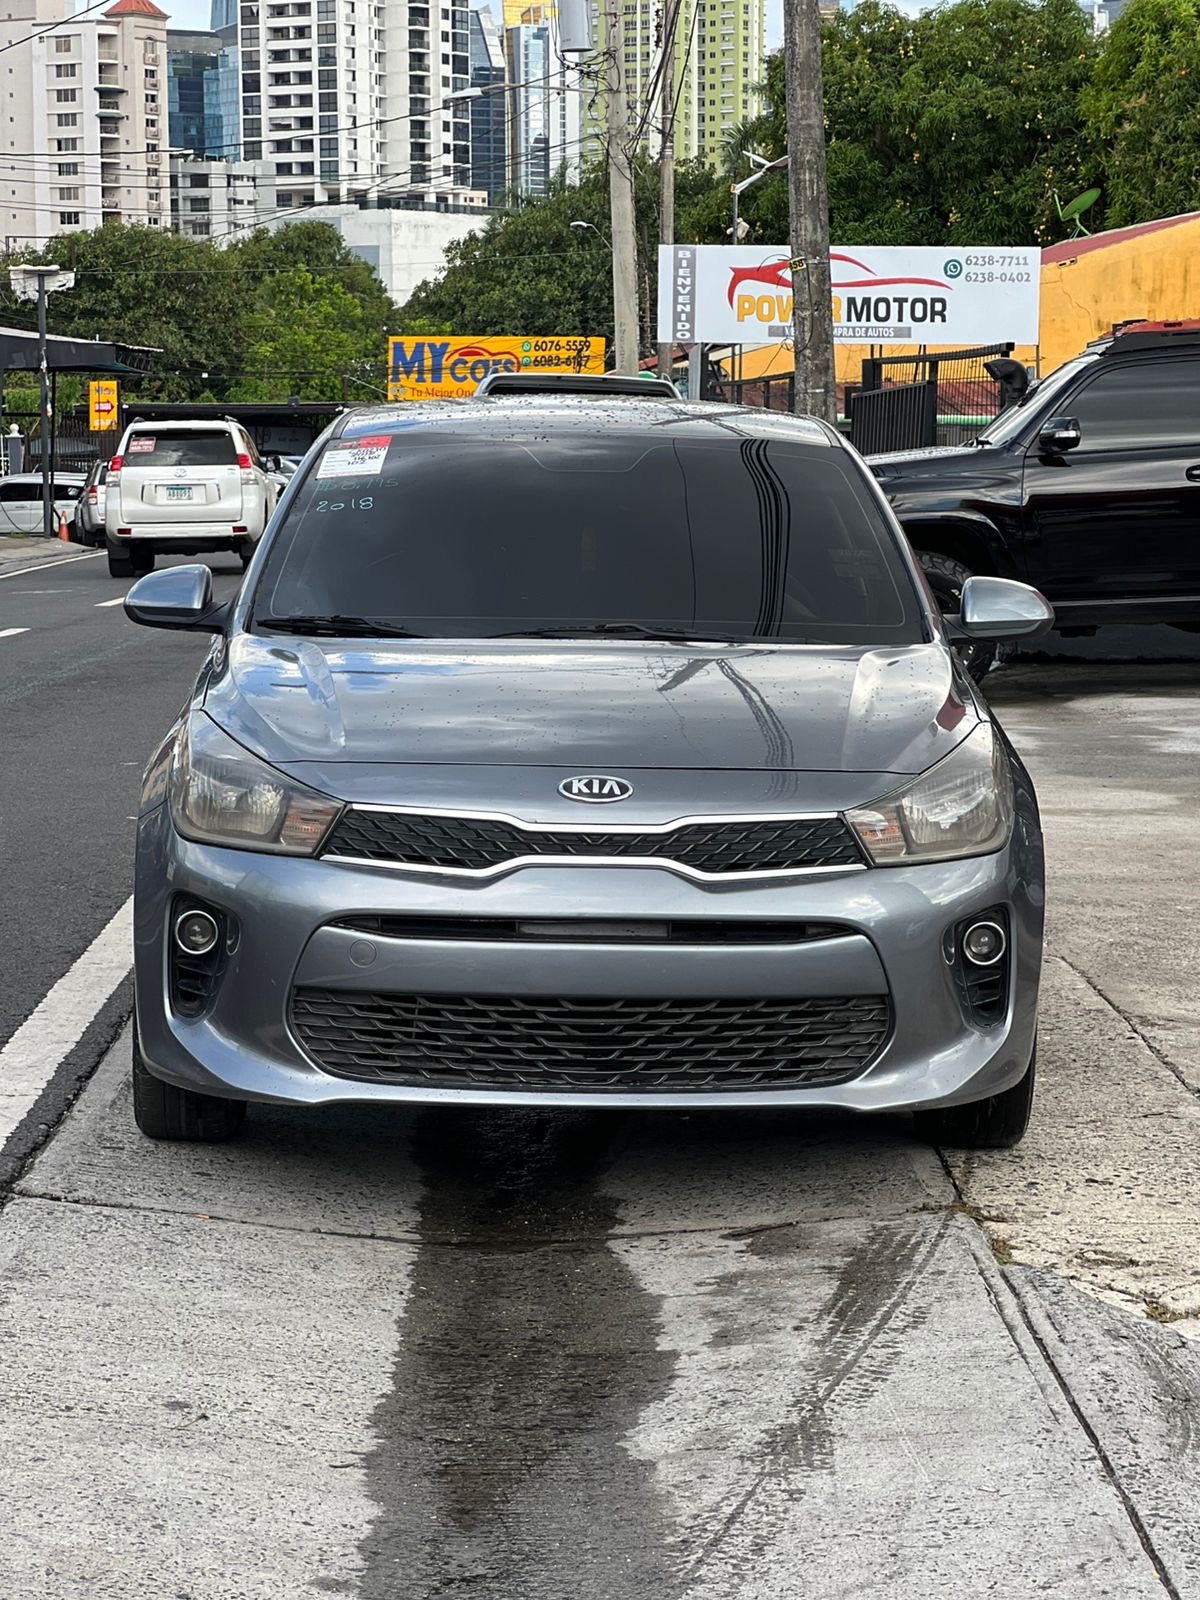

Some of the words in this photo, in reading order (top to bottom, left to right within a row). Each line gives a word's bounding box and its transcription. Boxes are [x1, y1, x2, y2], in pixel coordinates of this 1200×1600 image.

[965, 255, 1029, 267] 6238-7711
[965, 272, 1031, 283] 6238-0402
[676, 250, 692, 339] BIENVENIDO
[736, 295, 842, 323] POWR
[846, 297, 947, 323] MOTOR
[855, 327, 867, 337] DE
[867, 327, 895, 337] AUTOS
[533, 340, 591, 352] 6076-5559
[390, 342, 450, 383] MY
[316, 497, 374, 512] 2018
[571, 779, 622, 795] KIA
